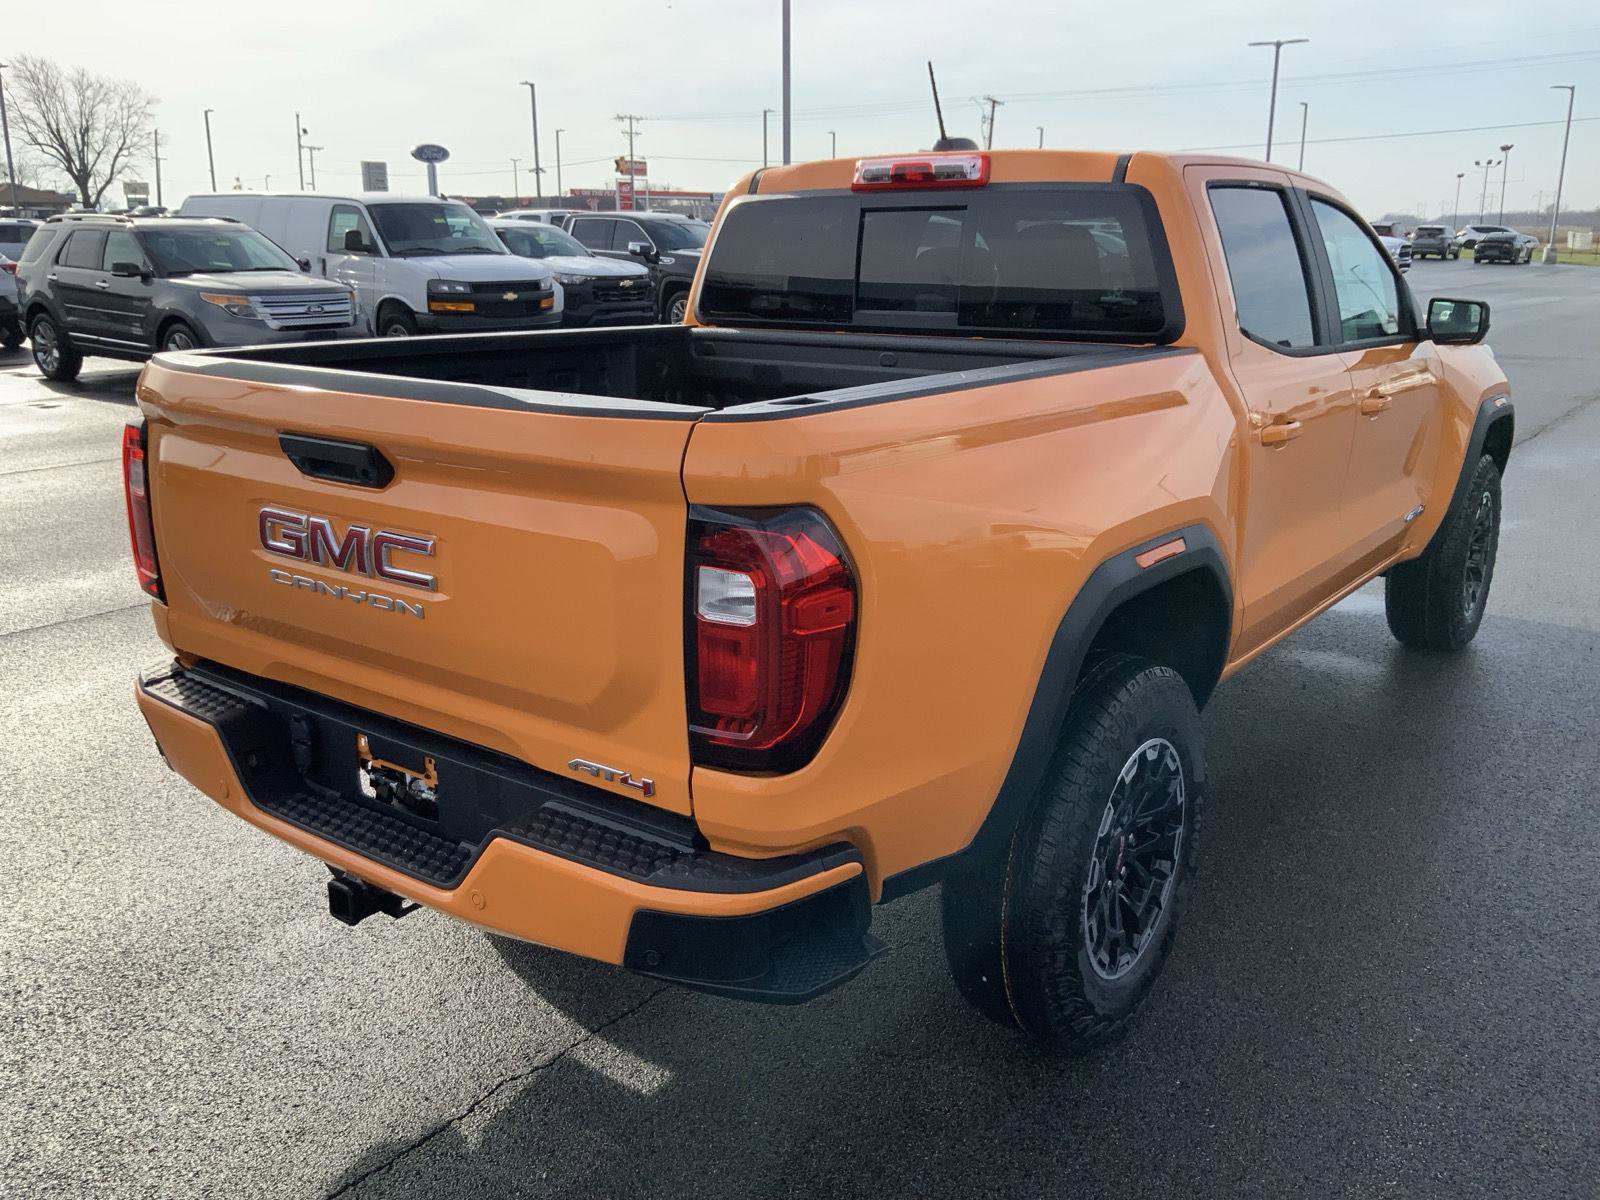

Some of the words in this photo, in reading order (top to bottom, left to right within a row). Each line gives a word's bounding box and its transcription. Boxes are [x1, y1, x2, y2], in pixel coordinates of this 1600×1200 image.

[421, 147, 444, 159] Ford
[259, 506, 437, 592] GMC
[270, 569, 425, 619] CANYON
[568, 758, 655, 797] AT4
